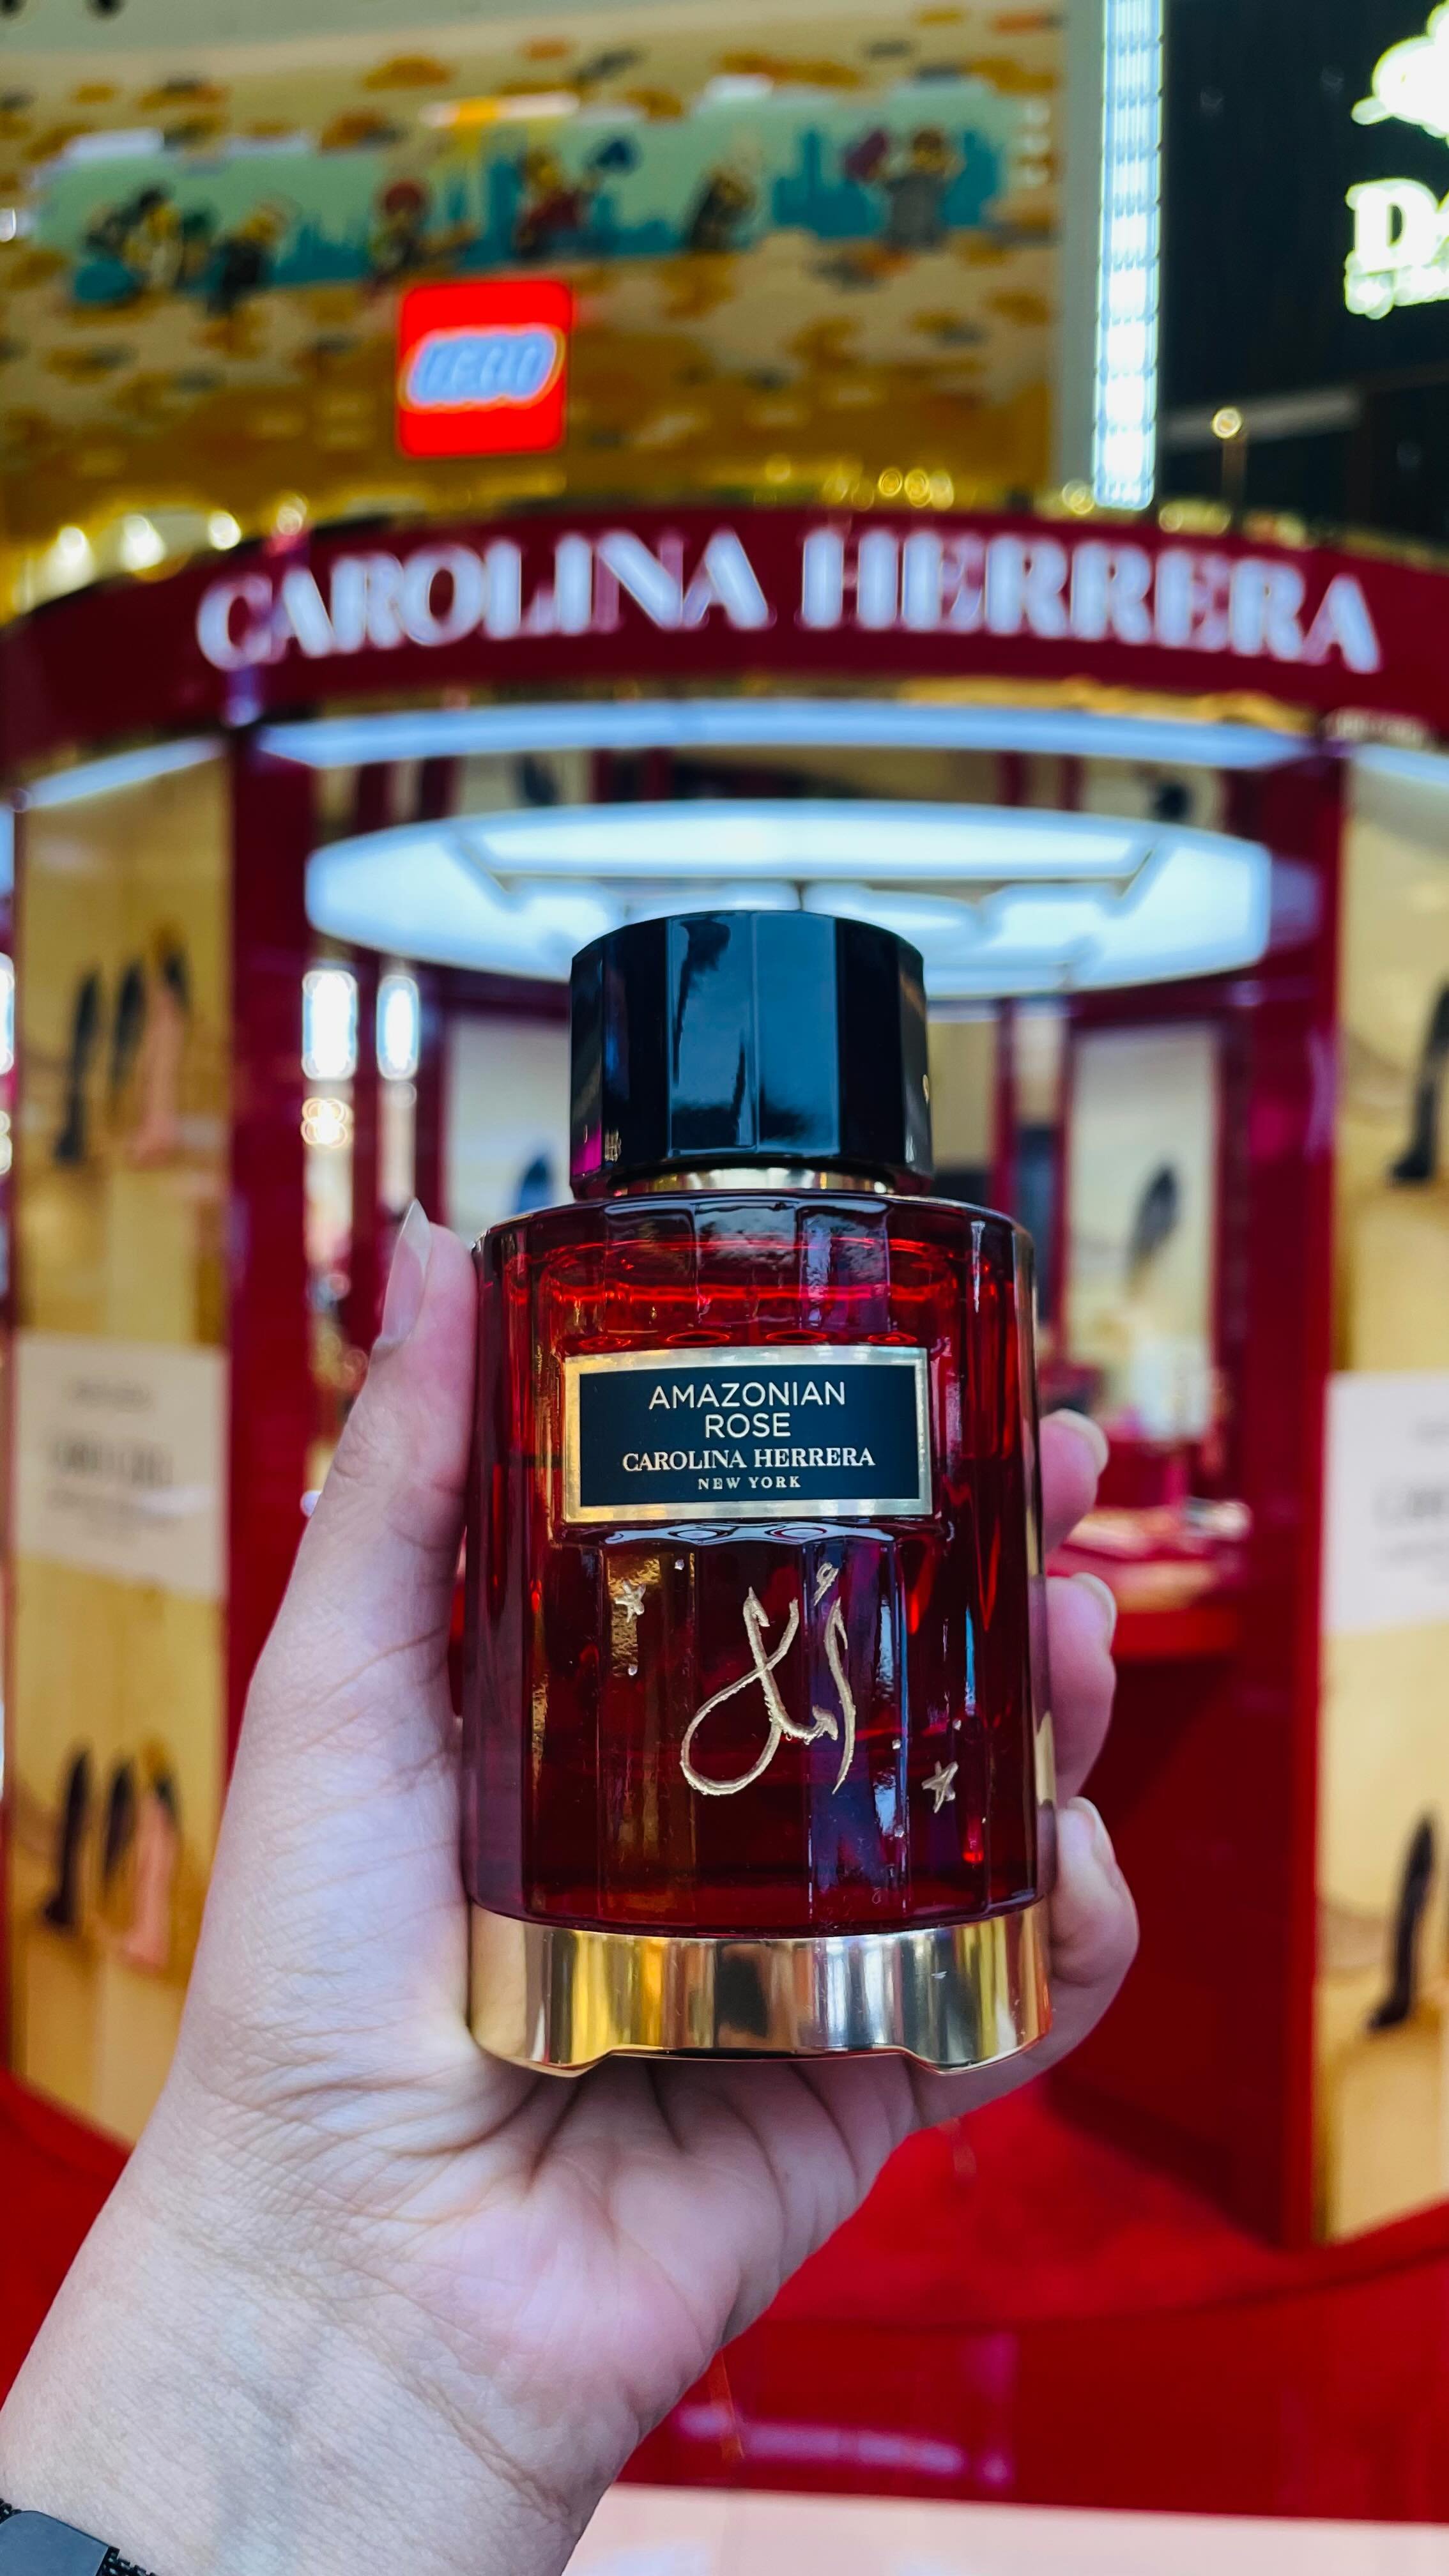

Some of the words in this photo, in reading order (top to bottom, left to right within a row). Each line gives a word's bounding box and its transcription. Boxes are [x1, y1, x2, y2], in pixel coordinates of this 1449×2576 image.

[195, 528, 770, 671] CAROLINA
[800, 527, 1381, 673] HERRERA
[648, 1381, 845, 1410] AMAZONIAN
[705, 1412, 791, 1438] ROSE
[622, 1450, 747, 1472] CAROLINA
[754, 1447, 876, 1468] HERRERA
[698, 1476, 740, 1490] NEW
[748, 1476, 801, 1489] YORK
